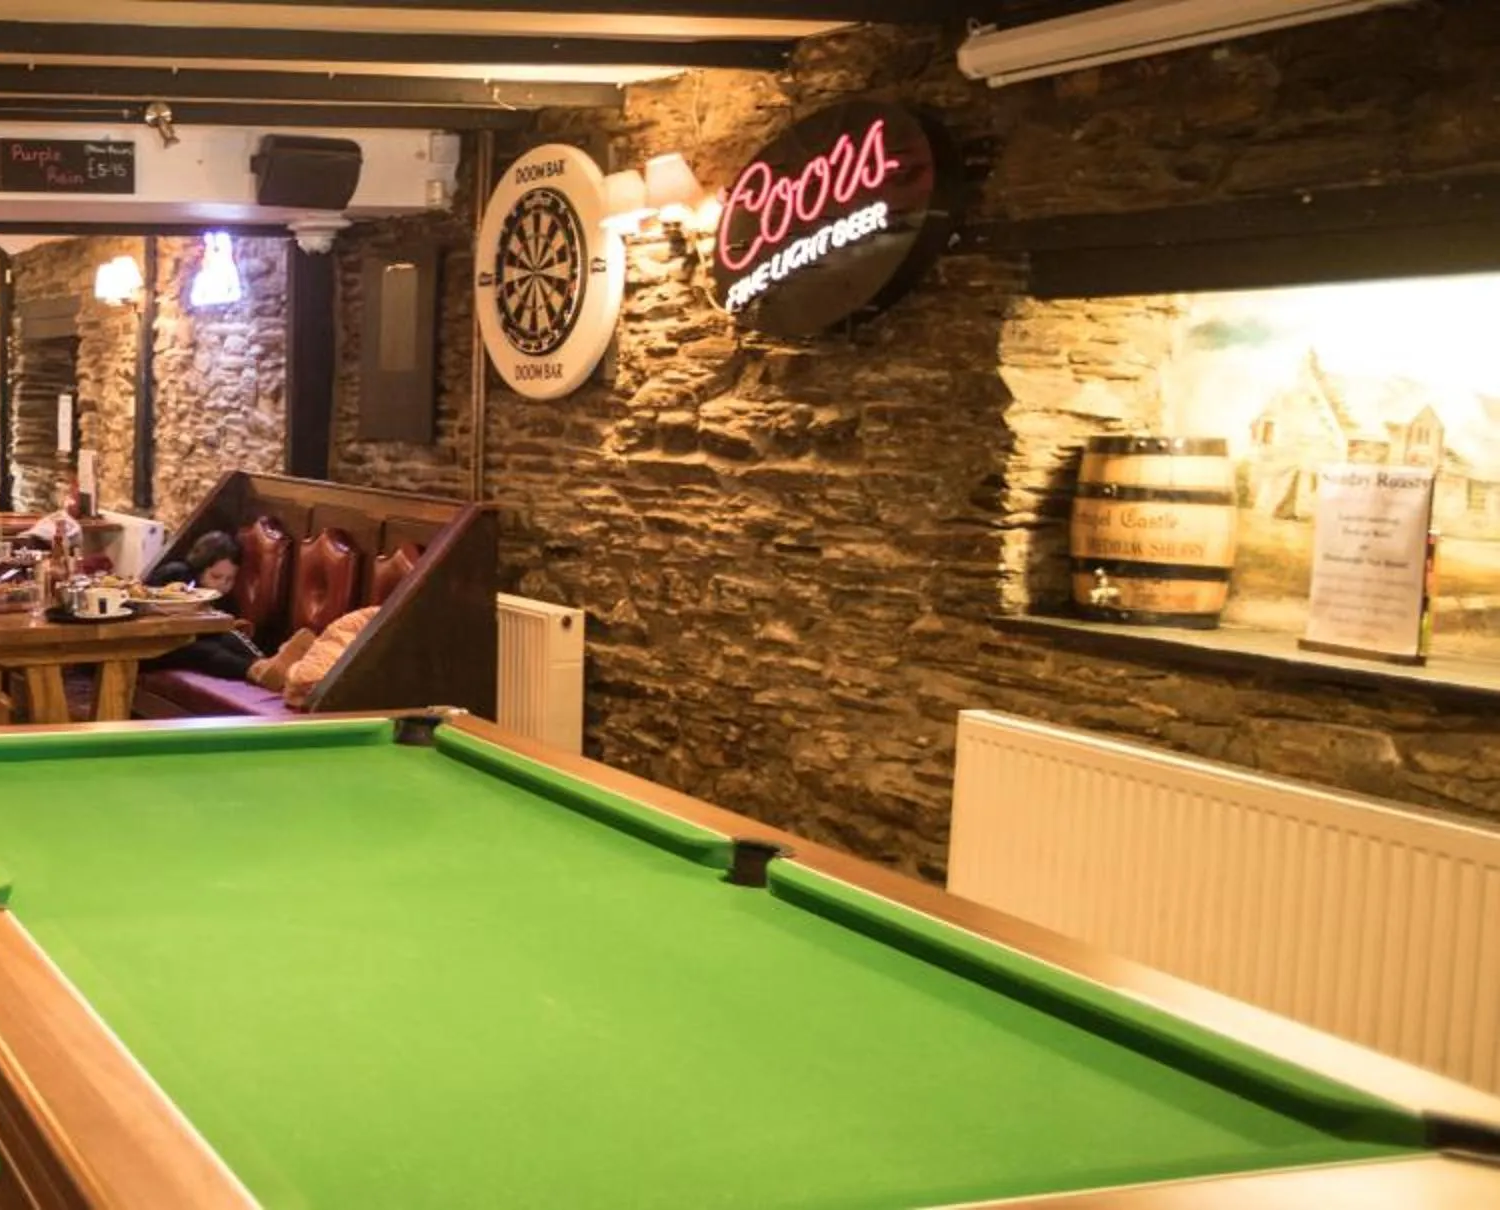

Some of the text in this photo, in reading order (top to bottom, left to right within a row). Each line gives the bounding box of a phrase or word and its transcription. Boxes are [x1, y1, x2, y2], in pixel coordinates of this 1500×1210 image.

[12, 144, 62, 166] Purple
[515, 158, 567, 185] DOOM BAR
[719, 119, 900, 271] Coors
[770, 225, 834, 281] LIGHT
[831, 200, 889, 248] BEER
[515, 363, 563, 382] DOOM BAR
[1323, 472, 1371, 489] Snday
[1120, 508, 1178, 530] Castle
